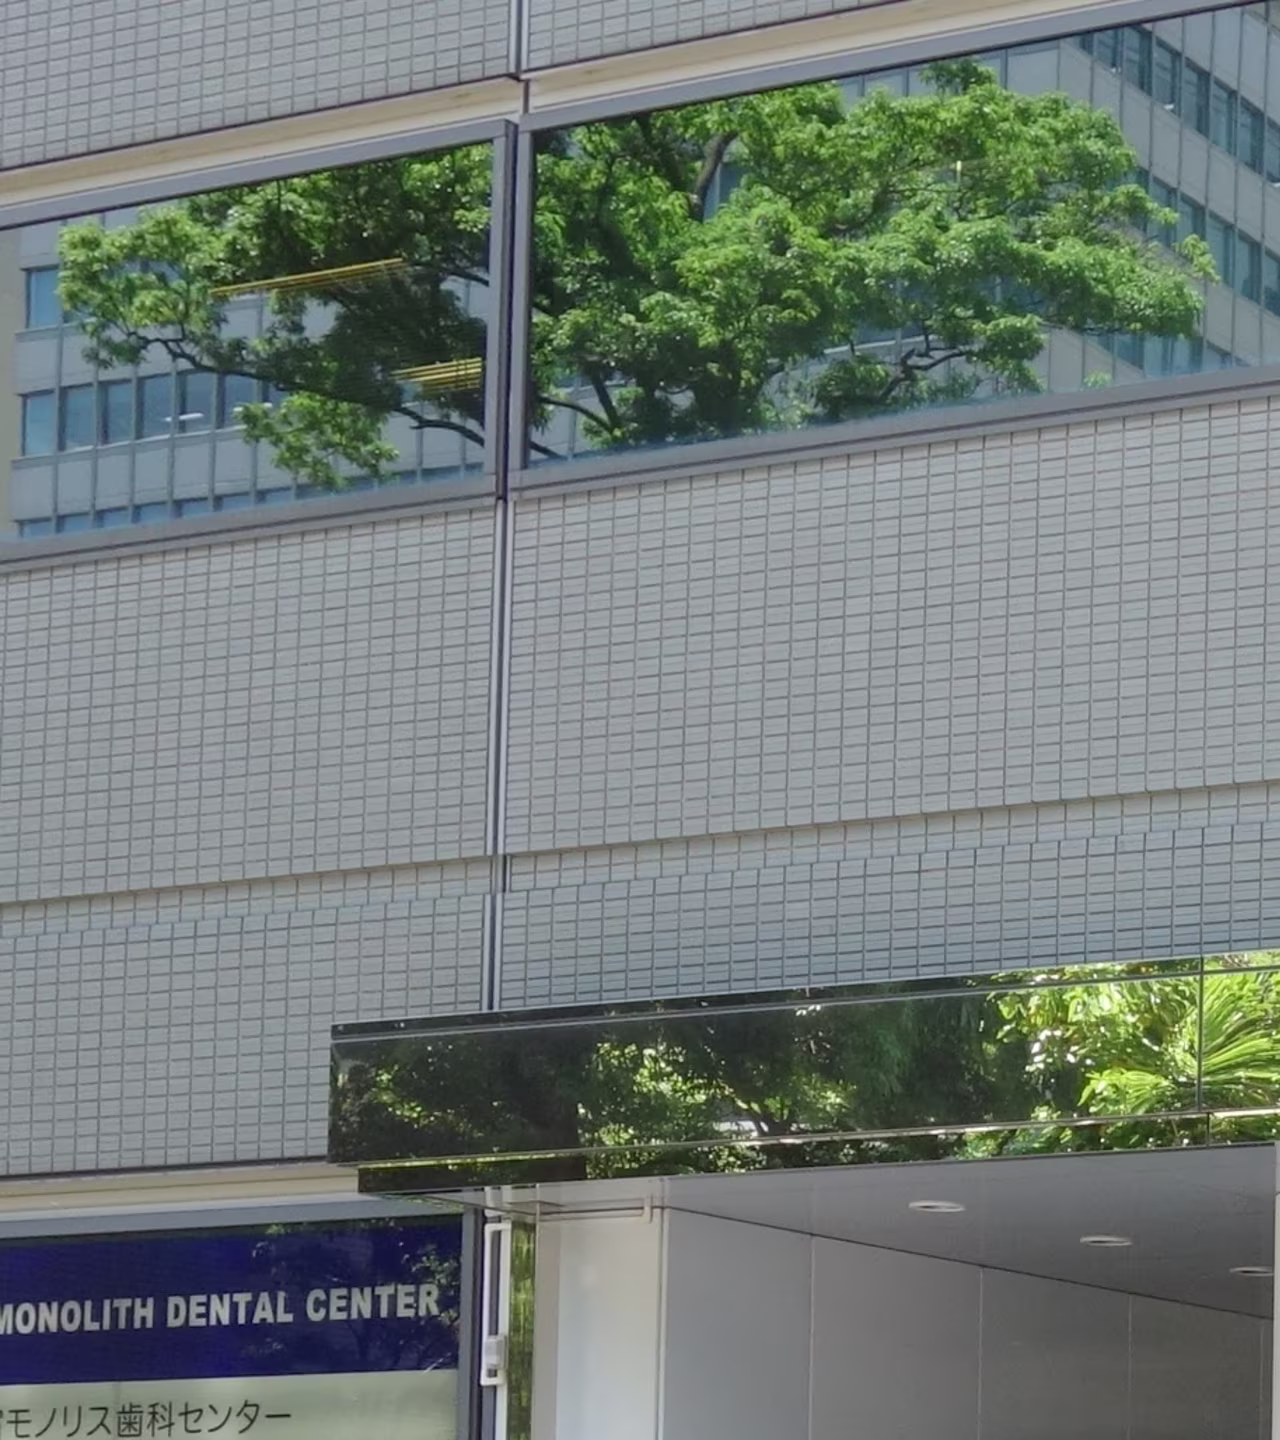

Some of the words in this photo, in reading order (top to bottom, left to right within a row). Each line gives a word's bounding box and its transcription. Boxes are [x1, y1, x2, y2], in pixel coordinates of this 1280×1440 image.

[0, 1297, 154, 1336] MONOLITH
[166, 1290, 294, 1328] DENTAL
[306, 1283, 440, 1322] CENTER
[0, 1399, 291, 1438] モノリス歯科センター
